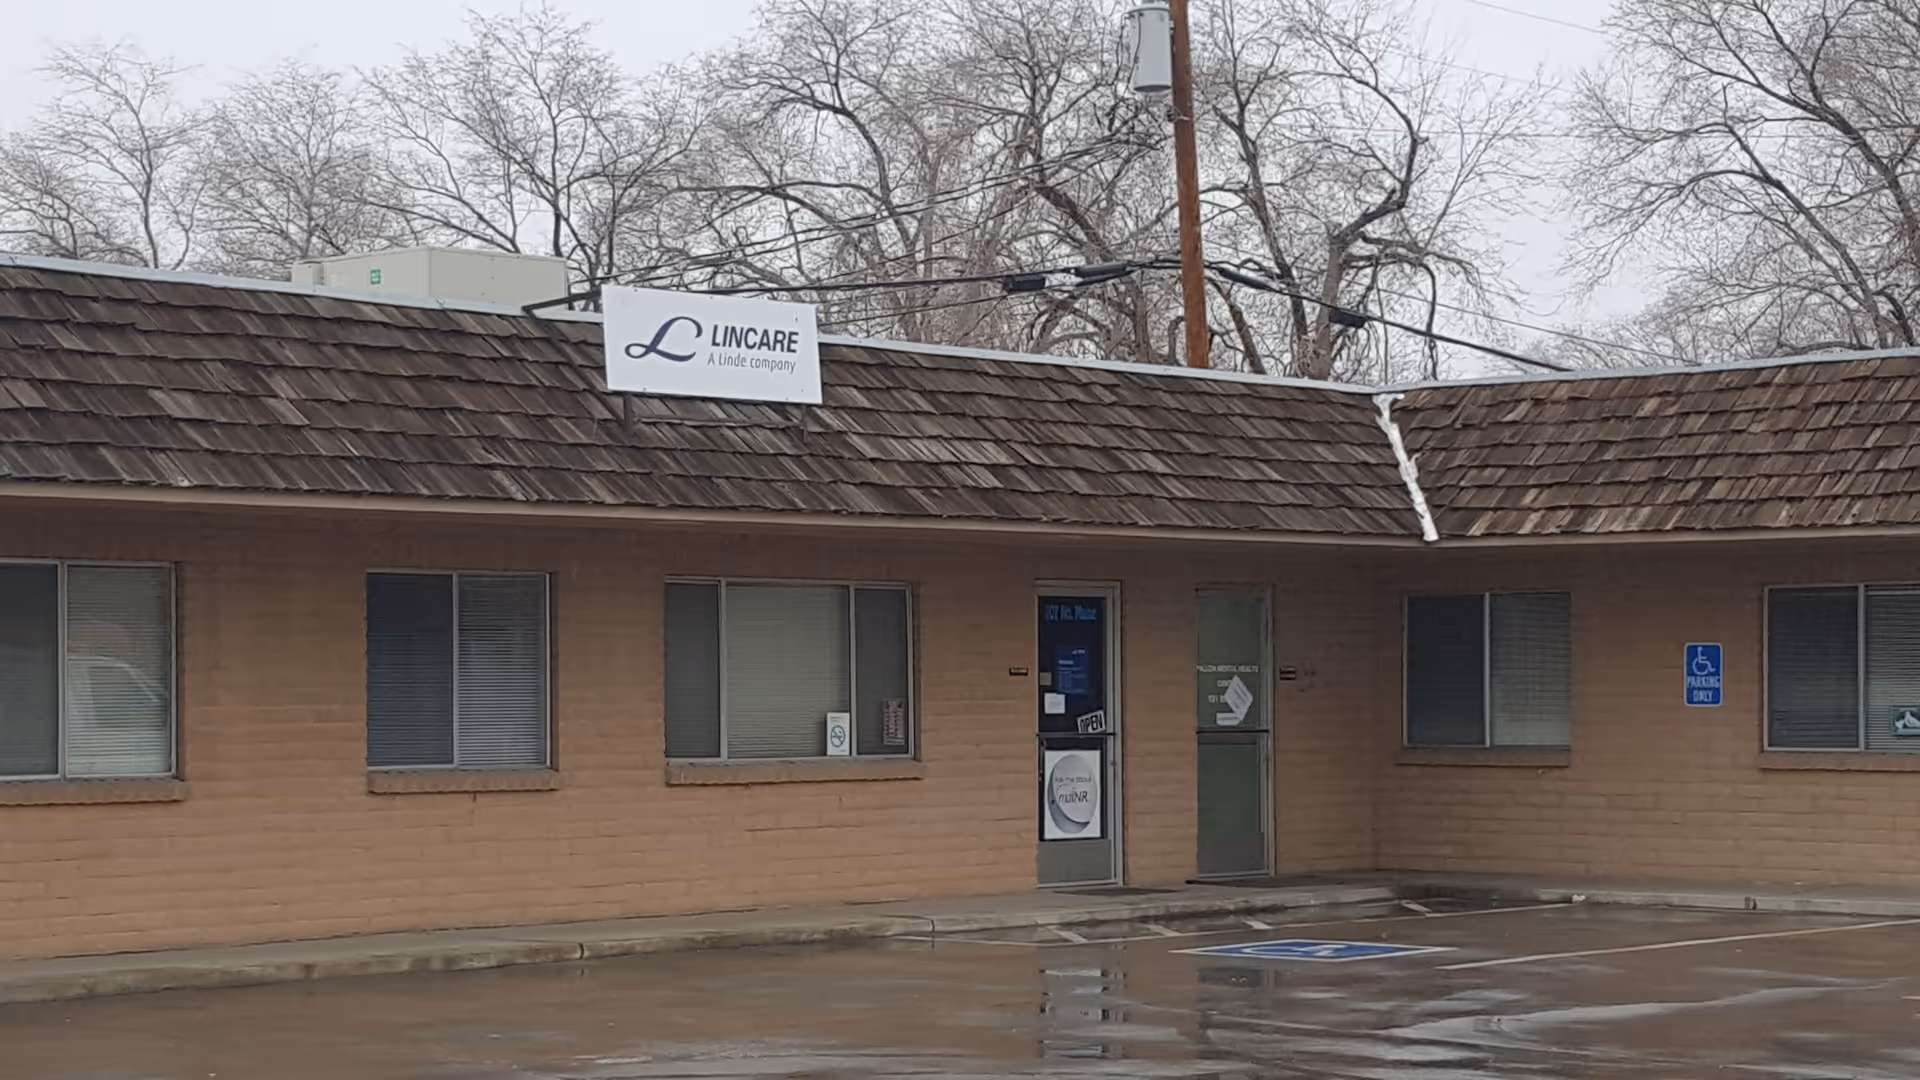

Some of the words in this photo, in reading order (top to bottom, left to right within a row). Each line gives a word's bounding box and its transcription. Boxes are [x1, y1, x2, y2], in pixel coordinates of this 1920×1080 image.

[711, 324, 799, 353] LINCARE
[707, 352, 716, 366] A
[718, 352, 747, 368] Linde
[750, 357, 796, 374] company
[1687, 676, 1720, 688] PARKING
[1693, 689, 1713, 702] ONLY
[1079, 713, 1103, 733] OPEN
